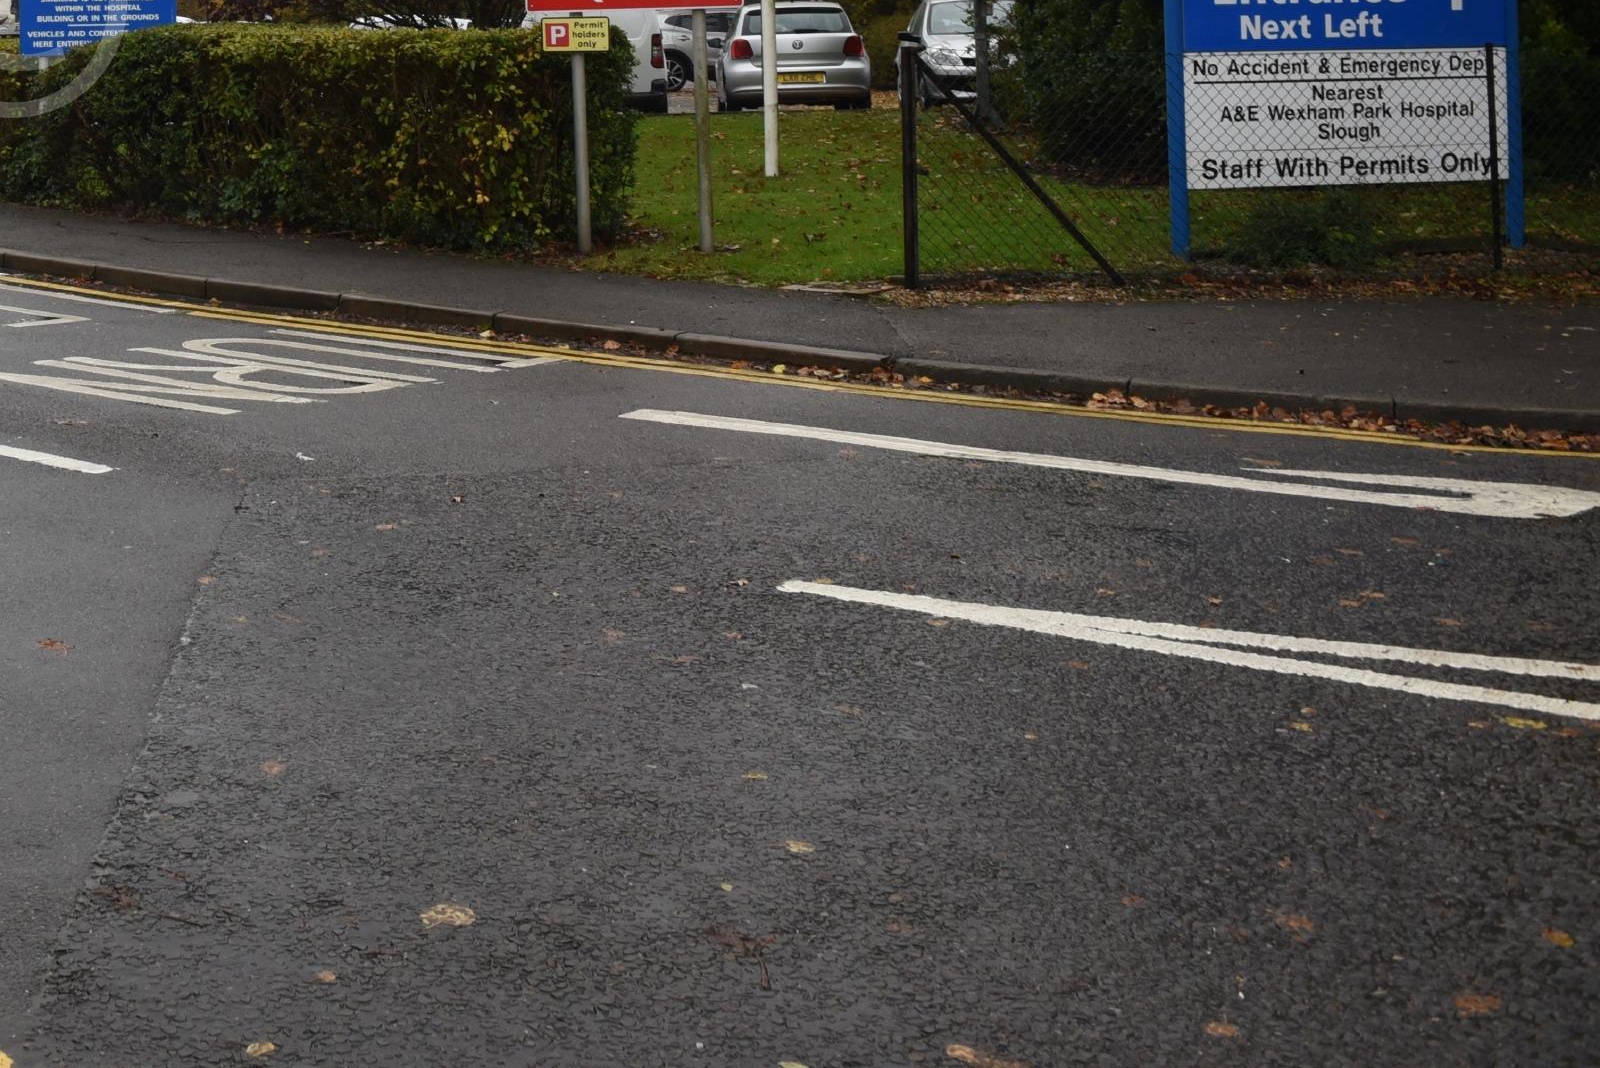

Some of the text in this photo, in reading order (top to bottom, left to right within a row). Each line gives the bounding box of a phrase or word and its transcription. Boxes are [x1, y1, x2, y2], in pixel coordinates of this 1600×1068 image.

[36, 15, 75, 23] BUILDING
[574, 21, 604, 29] Permit
[1240, 11, 1383, 40] Next Left
[27, 30, 65, 38] VEHICLES
[550, 25, 566, 45] P
[572, 31, 606, 39] holders
[32, 40, 54, 48] HERE
[577, 40, 597, 49] only
[1193, 55, 1486, 77] No Accident & Emergency Dep
[1313, 84, 1384, 101] Nearest
[1220, 101, 1474, 122] A&E Wexham Park Hospital
[1318, 123, 1380, 142] Slough
[1201, 152, 1492, 180] Staff With Permits Only
